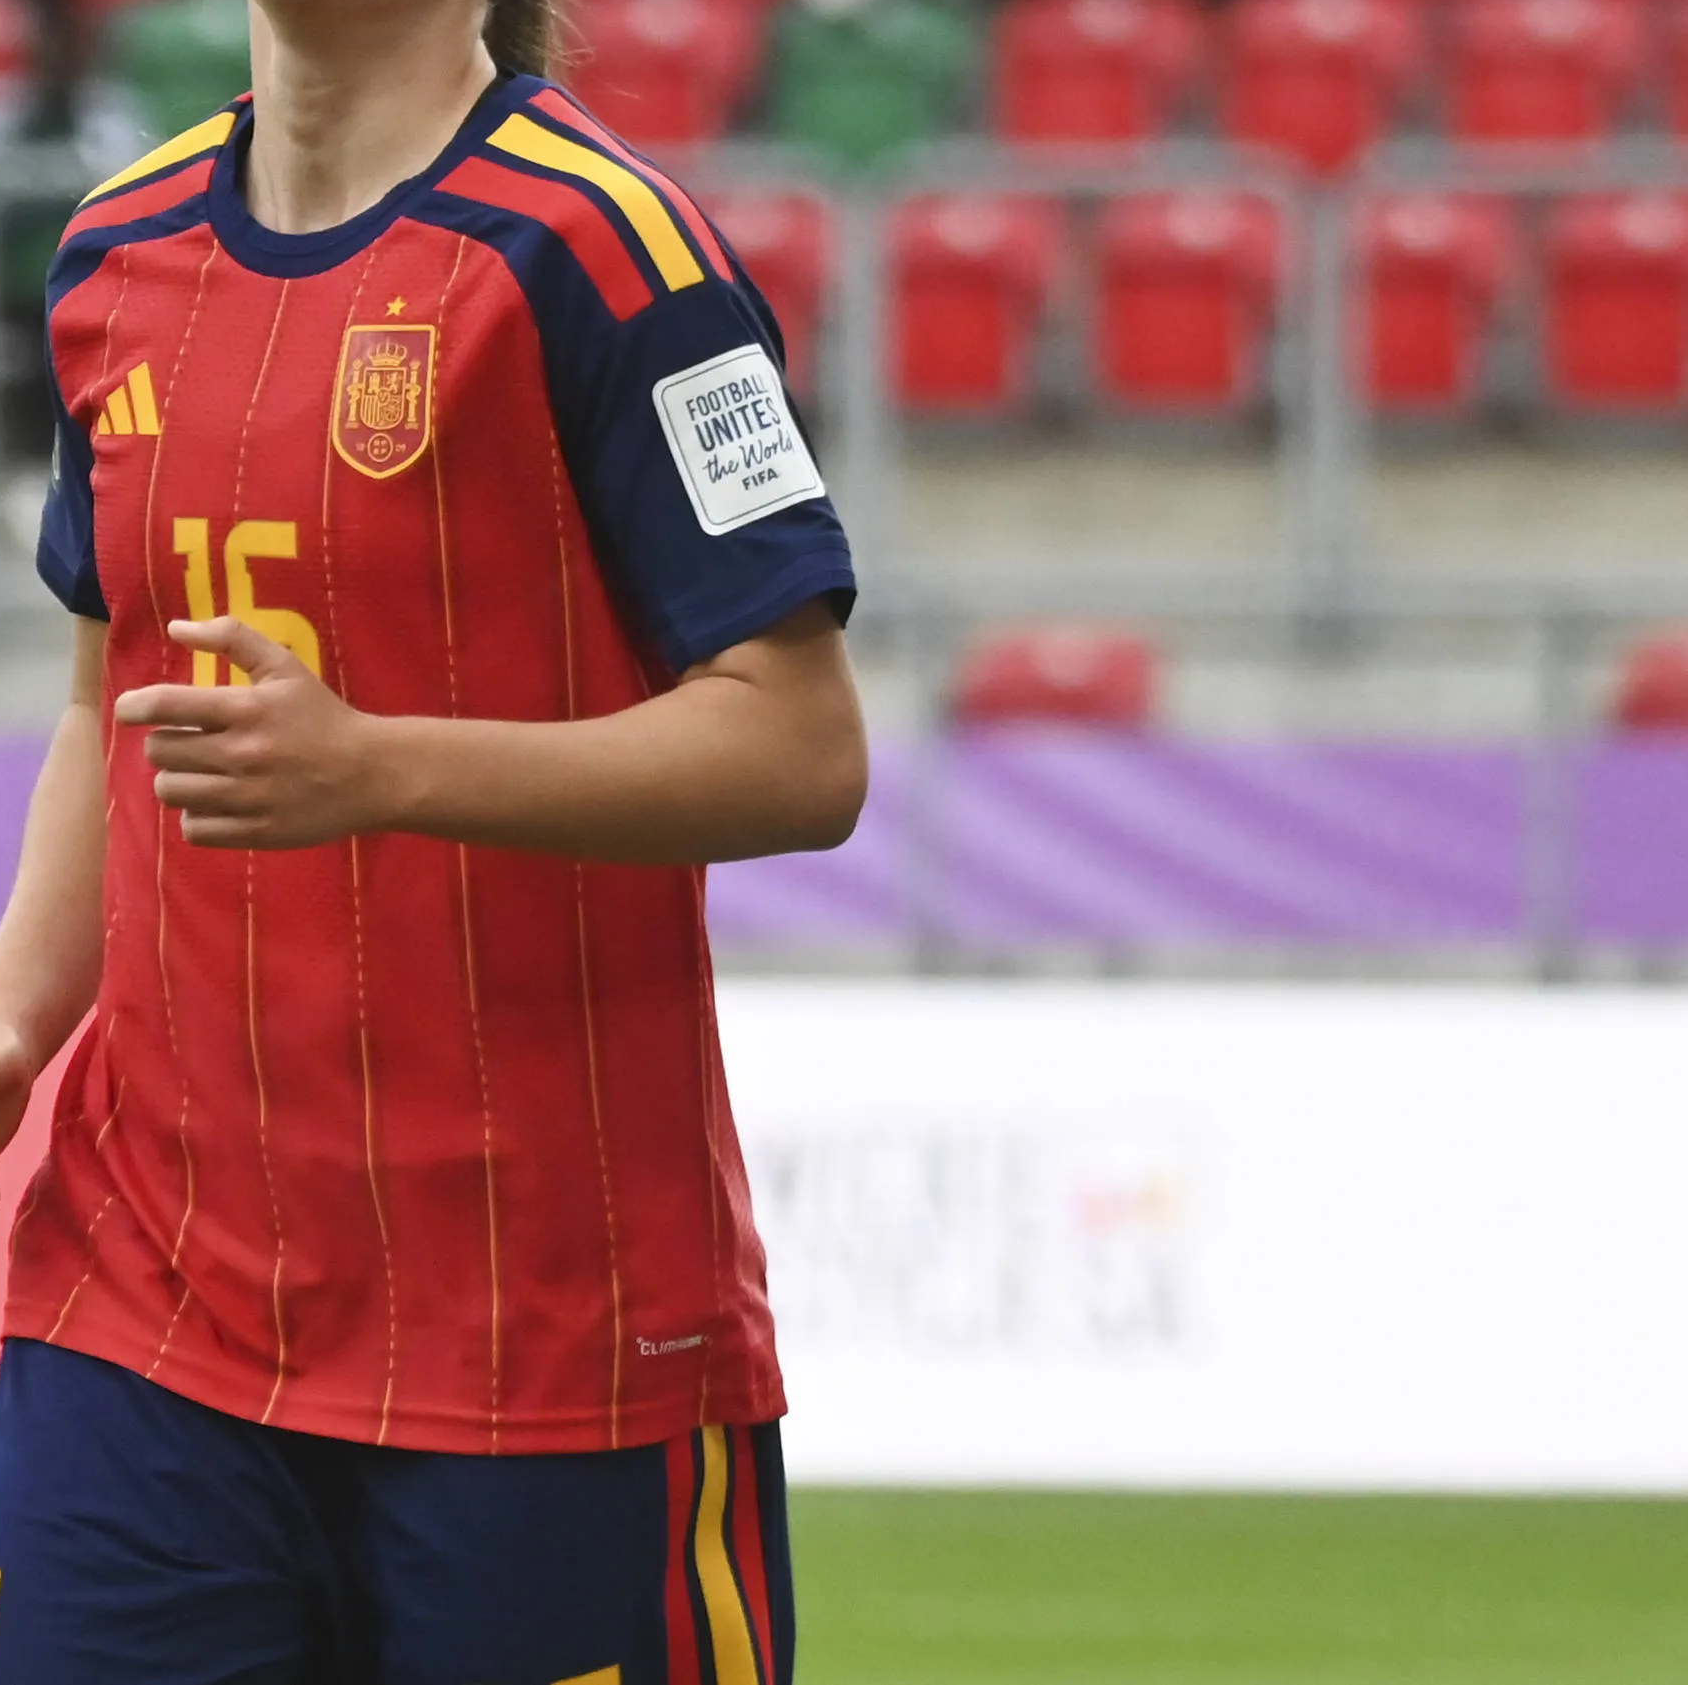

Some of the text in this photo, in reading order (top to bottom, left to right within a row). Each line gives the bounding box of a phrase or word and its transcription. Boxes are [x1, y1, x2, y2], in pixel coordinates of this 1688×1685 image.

[685, 374, 769, 421] FOOTBALL
[694, 396, 781, 452] UNITES
[702, 427, 794, 484] the World
[742, 467, 780, 491] FIFA
